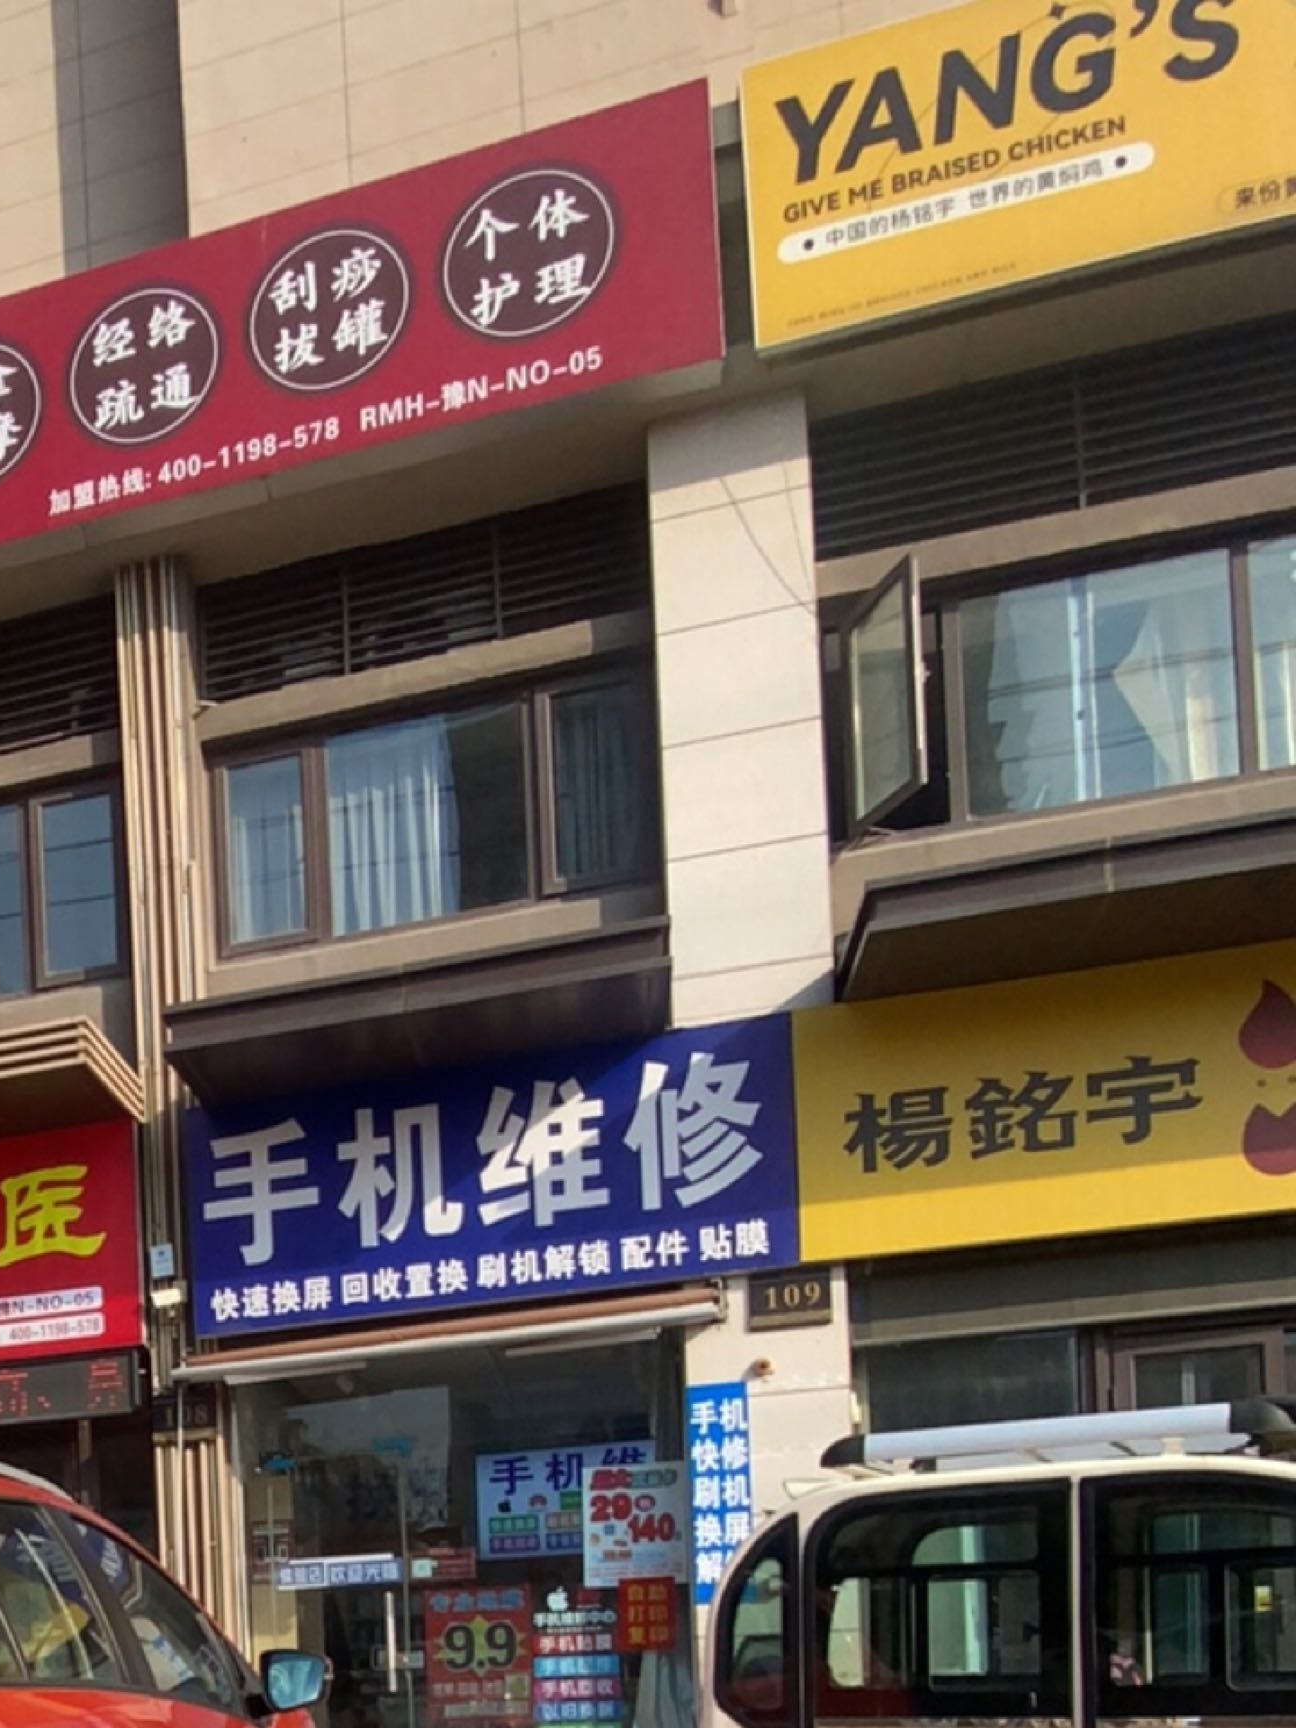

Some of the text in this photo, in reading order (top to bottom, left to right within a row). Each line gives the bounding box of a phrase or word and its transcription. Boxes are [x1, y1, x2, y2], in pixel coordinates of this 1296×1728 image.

[784, 115, 1126, 223] GIVE ME BRAISED CHICKEN
[463, 188, 590, 264] 个体
[268, 247, 382, 316] 刮痧
[469, 254, 592, 329] 护理
[93, 301, 197, 367] 经络
[271, 298, 390, 373] 拔罐
[93, 363, 197, 431] 疏通
[844, 1055, 1203, 1174] 楊銘宇
[203, 1051, 764, 1267] 手机维修
[211, 1219, 771, 1321] 快速换屏 回收置换 刷机解锁 配件 贴膜
[765, 1281, 822, 1311] 109
[690, 1398, 747, 1434] 手机
[445, 1623, 516, 1669] 9.9
